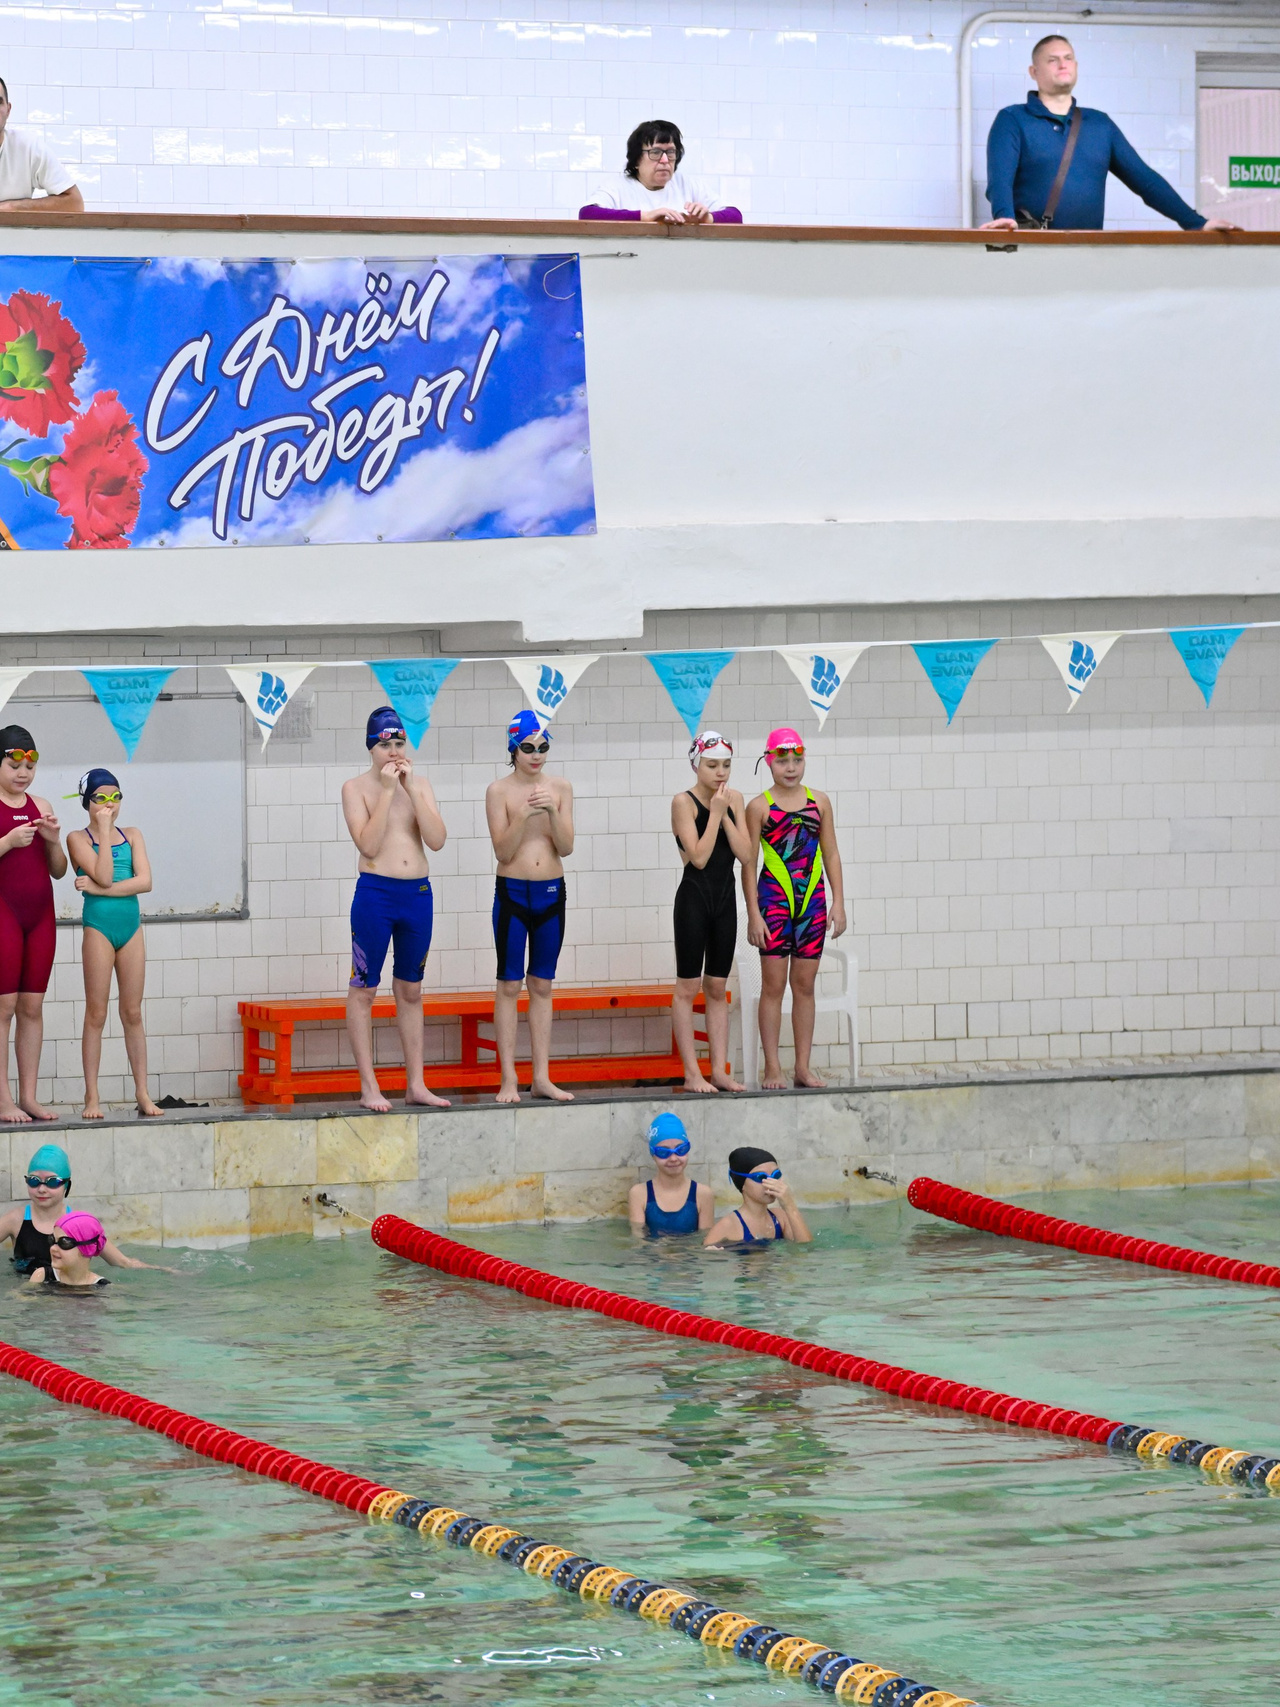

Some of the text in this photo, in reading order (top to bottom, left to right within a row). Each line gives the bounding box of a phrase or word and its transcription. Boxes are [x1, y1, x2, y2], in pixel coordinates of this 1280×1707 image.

[145, 270, 450, 453] С Днём
[169, 327, 501, 541] Победы!
